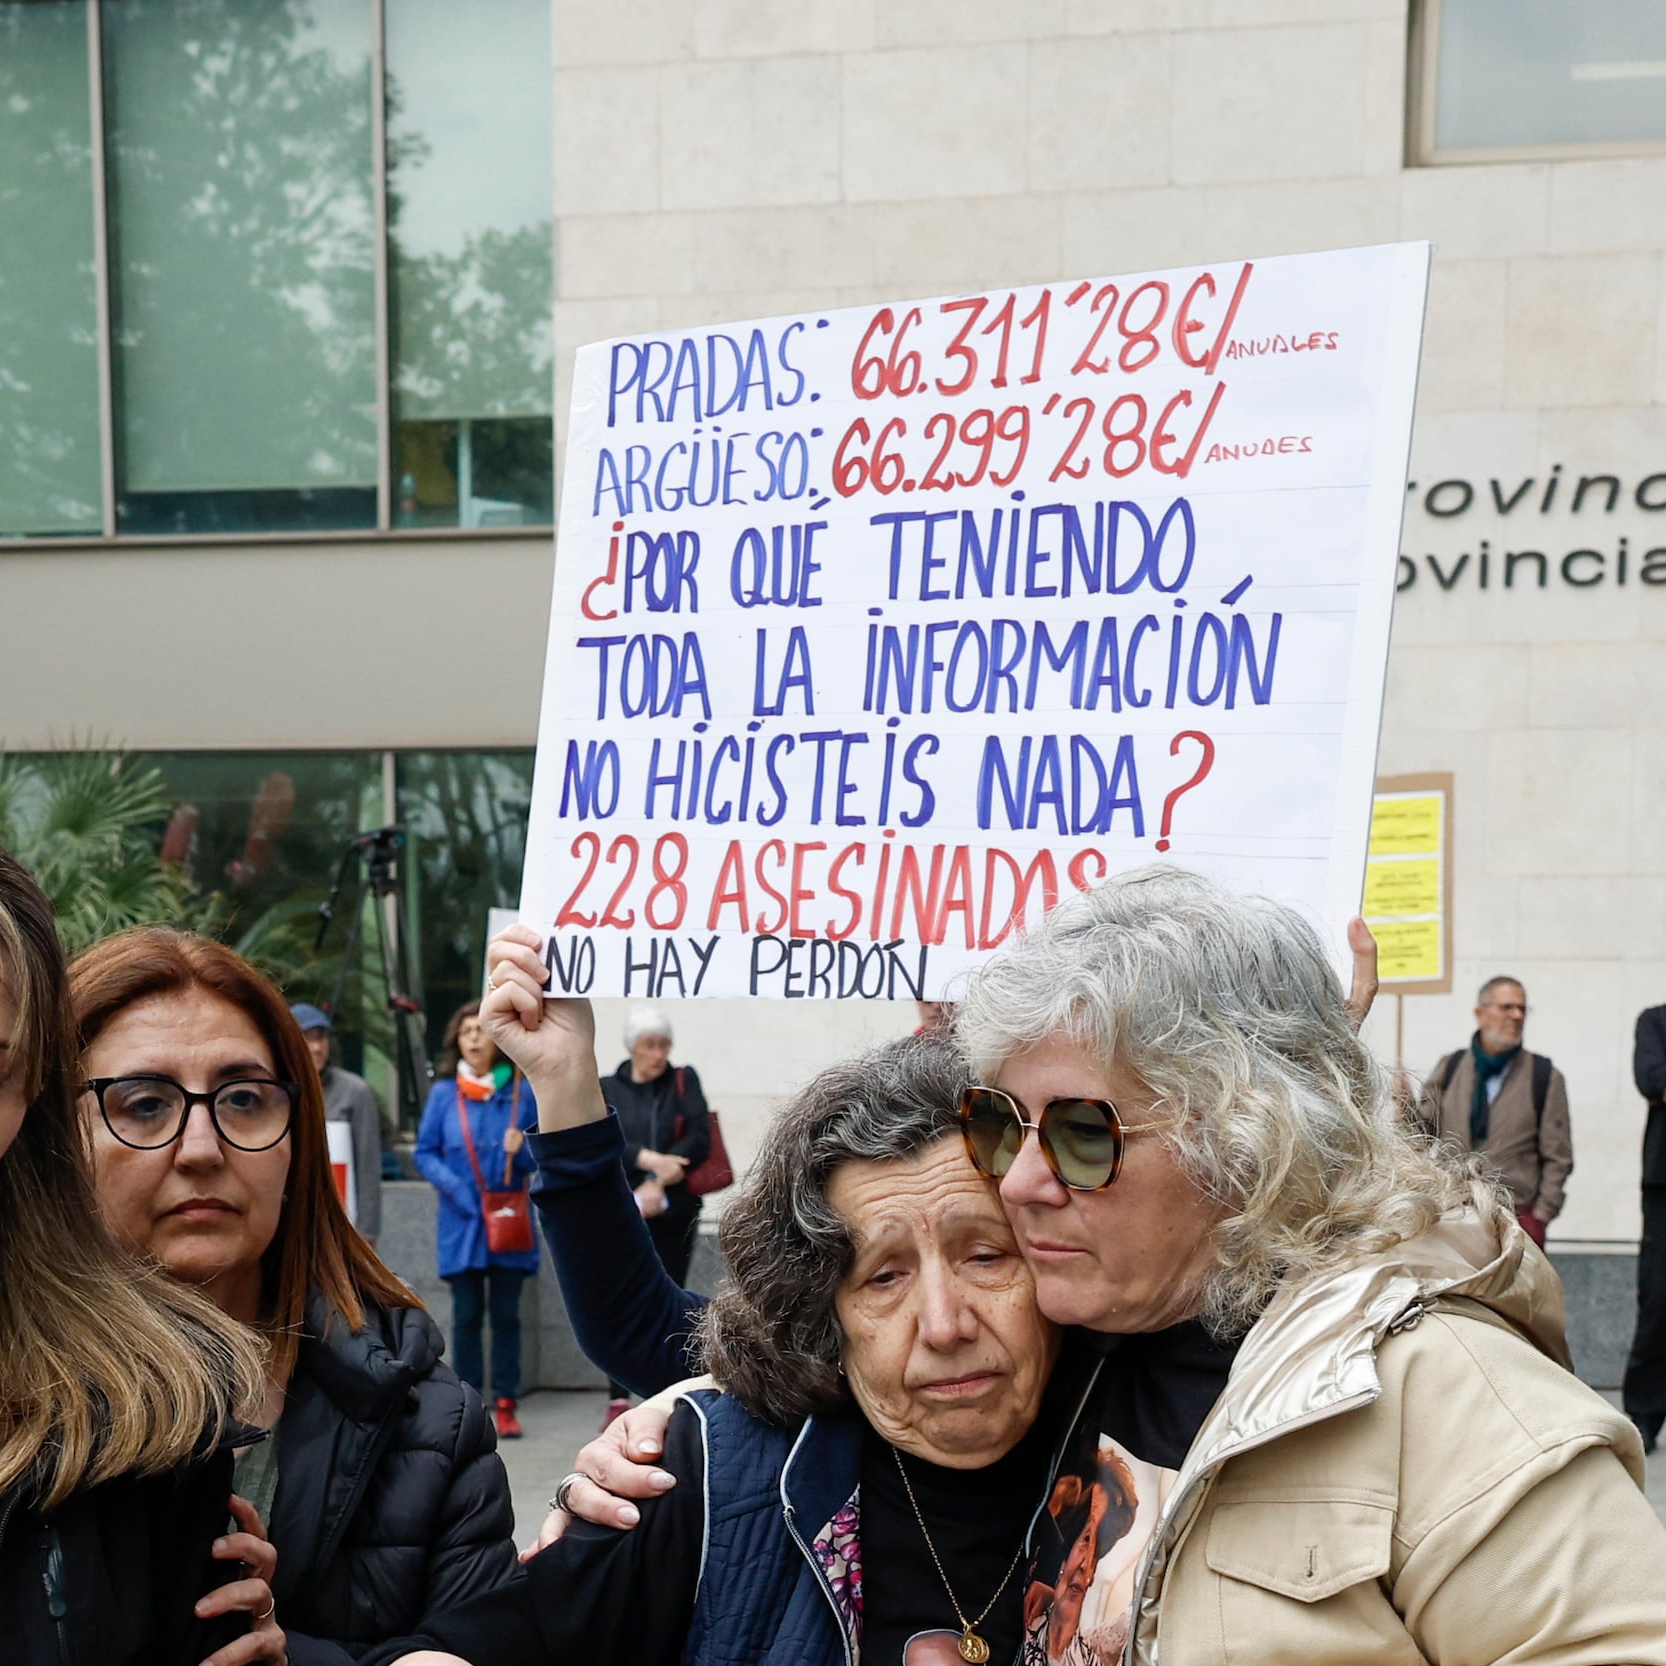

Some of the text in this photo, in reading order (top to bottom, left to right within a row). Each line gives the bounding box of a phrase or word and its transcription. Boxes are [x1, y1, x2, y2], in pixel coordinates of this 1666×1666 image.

[607, 318, 830, 428] PRADAS:
[592, 425, 824, 518] ARGÜESO:
[581, 490, 1197, 622] ¿POR QUÉ TENIENDO
[575, 574, 1282, 721] TODA LA INFORMACIÓN
[558, 735, 622, 822] NO
[644, 717, 940, 830] HICISTEIS
[554, 830, 690, 931] 228
[544, 932, 928, 1000] NO HAY PERDÓN
